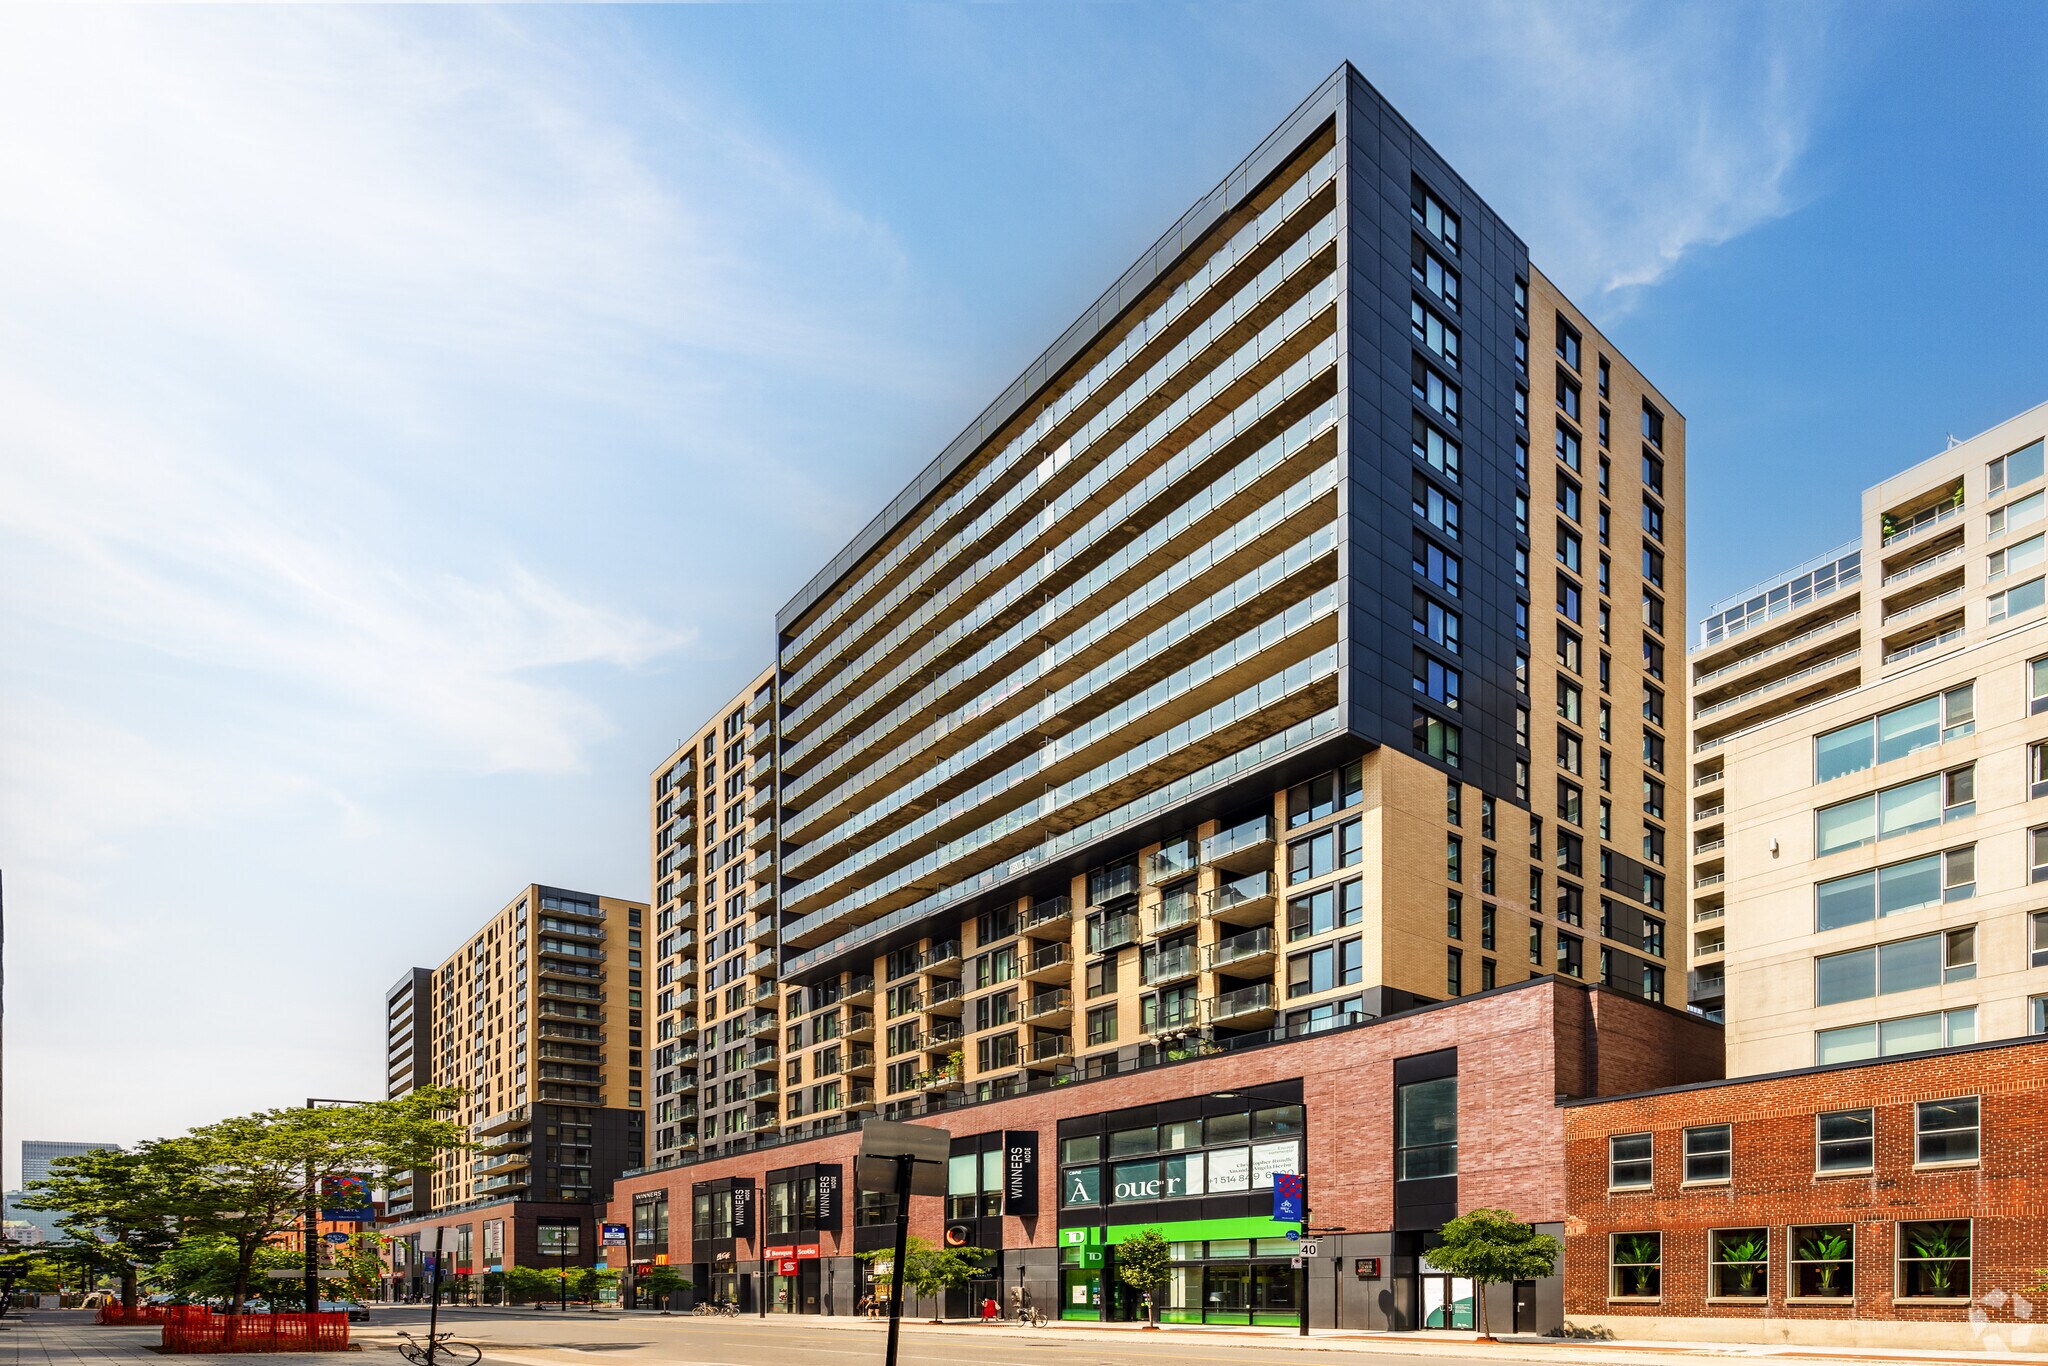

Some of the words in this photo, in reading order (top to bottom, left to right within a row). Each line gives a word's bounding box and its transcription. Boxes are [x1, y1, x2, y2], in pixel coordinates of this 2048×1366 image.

[1011, 1147, 1022, 1198] WINNERS
[1220, 1174, 1236, 1184] 514
[635, 1190, 662, 1200] WINNERS
[1069, 1177, 1091, 1203] À
[1114, 1177, 1181, 1199] ouer
[820, 1176, 830, 1218] WINNERS
[735, 1189, 745, 1226] WINNERS
[1065, 1231, 1085, 1244] TD
[1086, 1252, 1102, 1260] TD
[1301, 1244, 1317, 1255] 40
